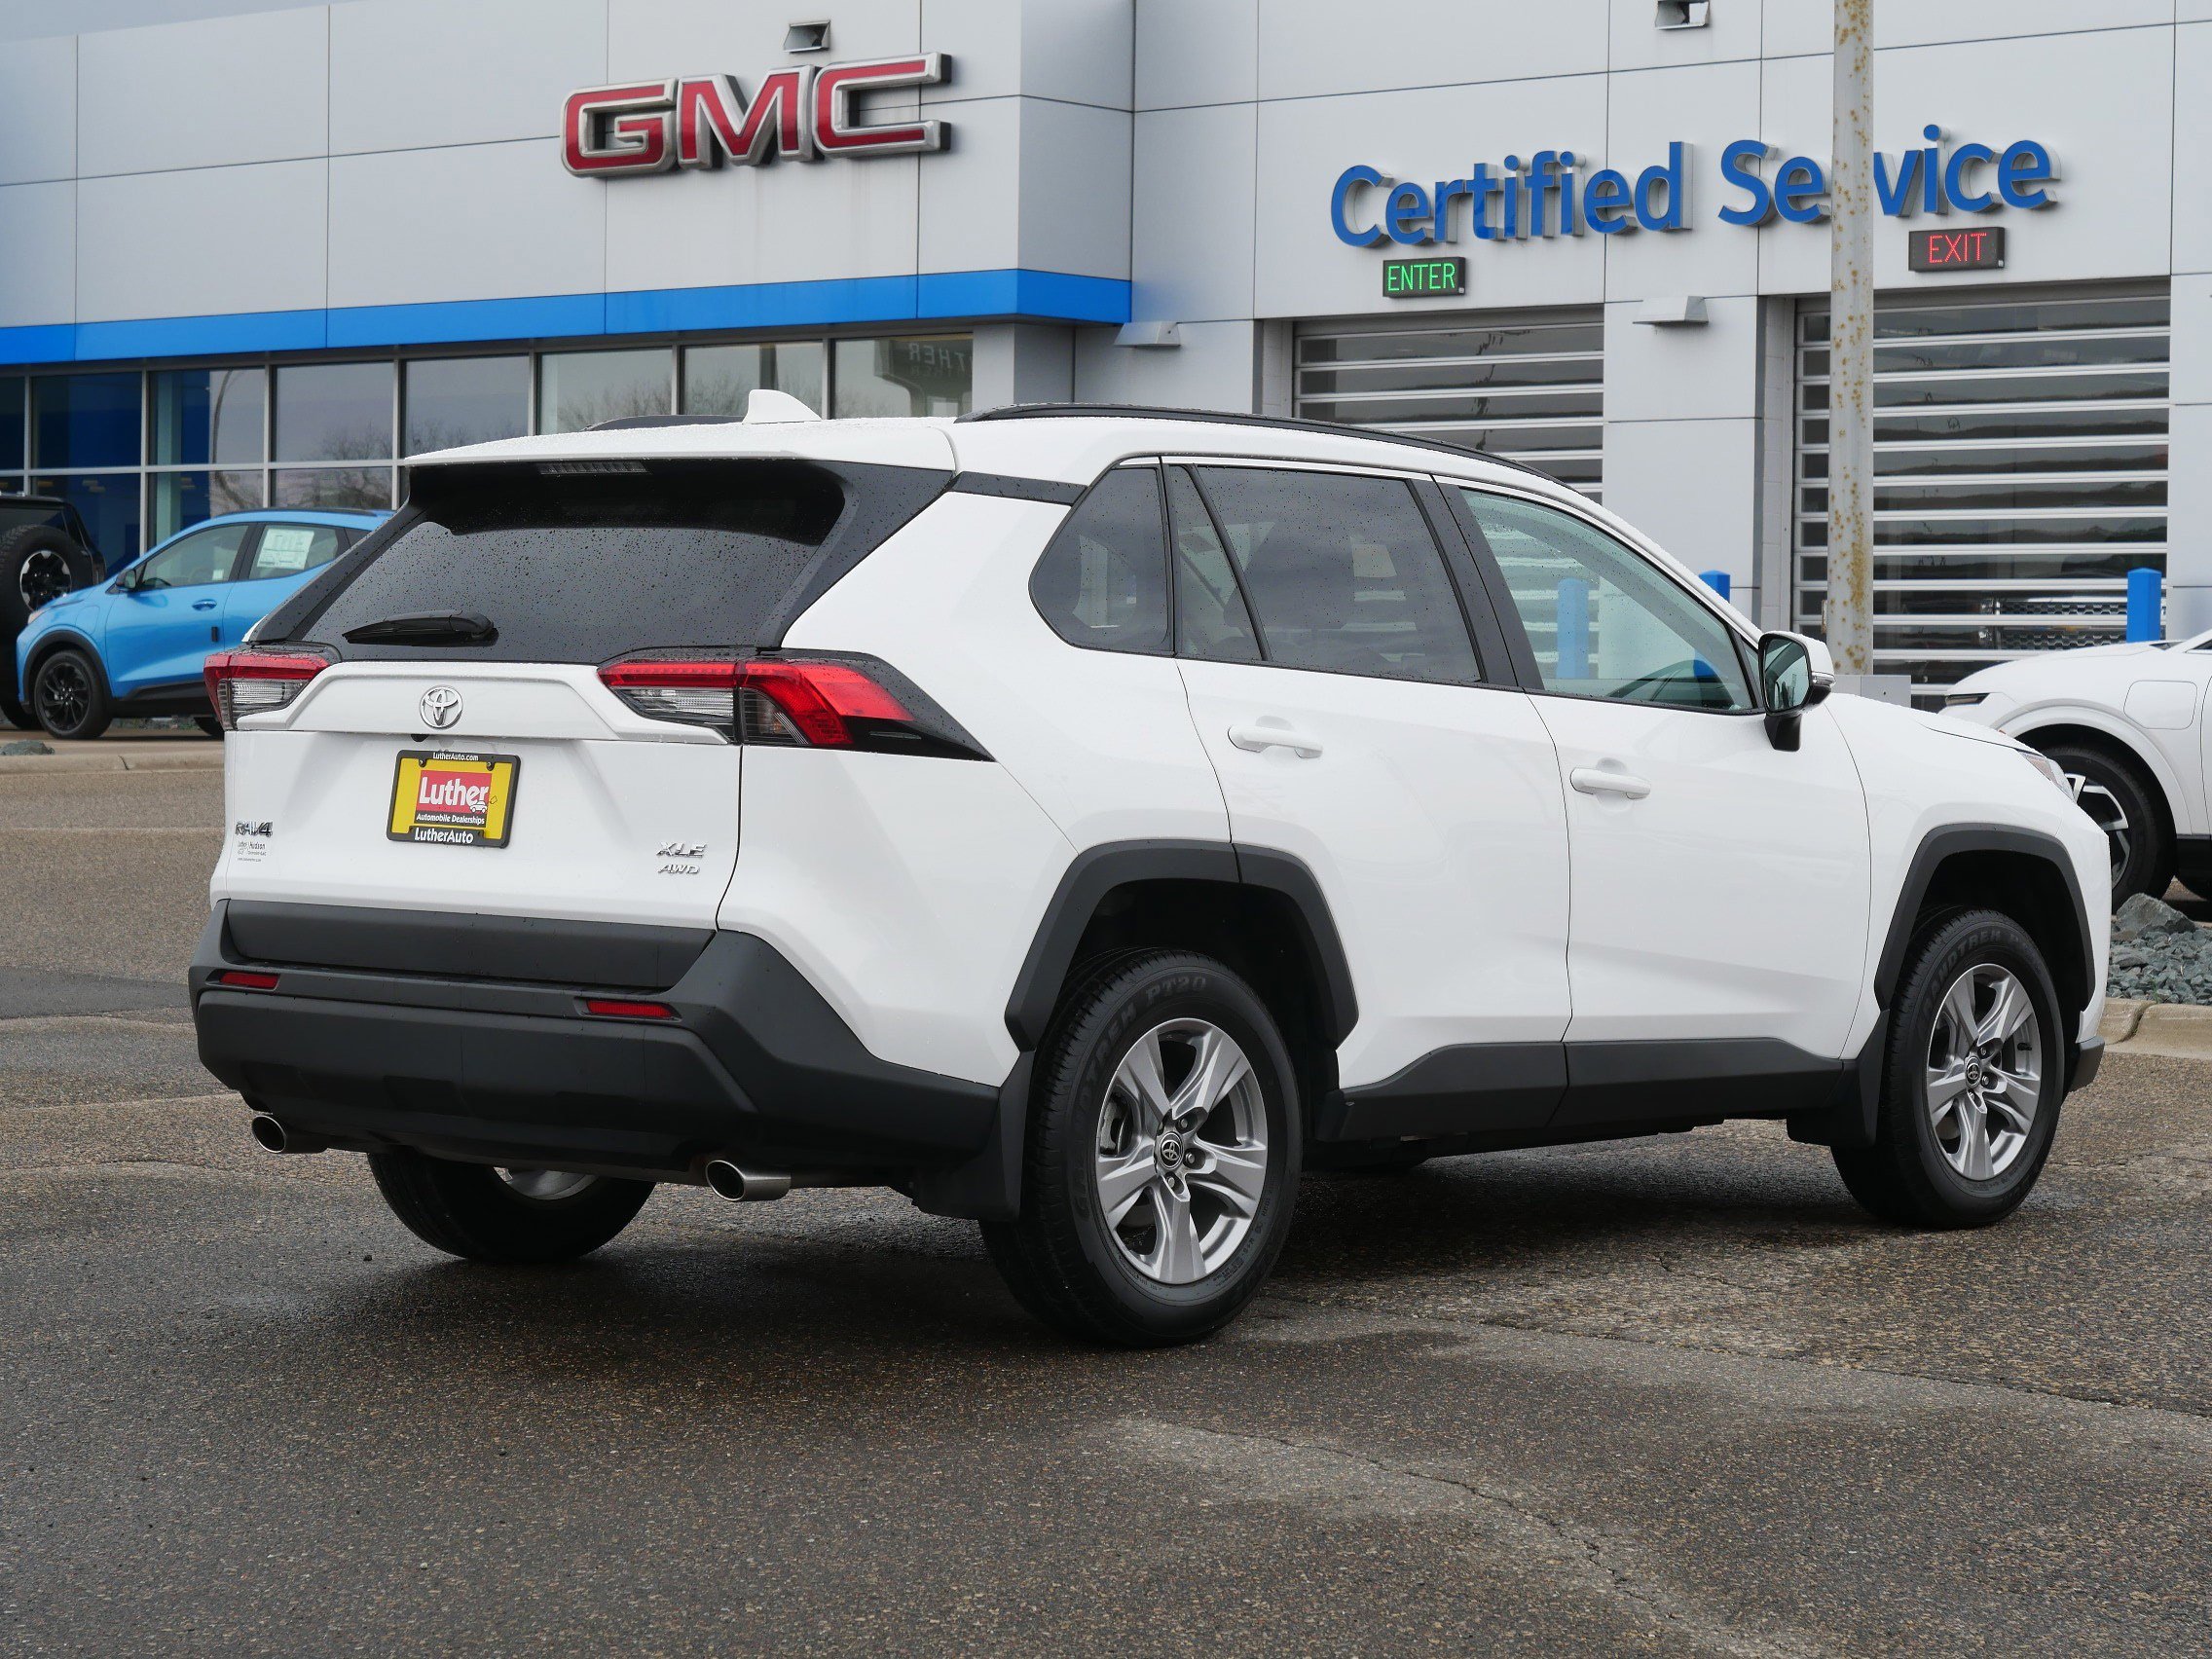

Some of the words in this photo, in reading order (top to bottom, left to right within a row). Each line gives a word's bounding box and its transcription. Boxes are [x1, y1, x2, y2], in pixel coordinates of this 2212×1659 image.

[560, 52, 951, 177] GMC
[1330, 141, 1693, 248] Certified
[1717, 124, 2061, 226] Sevice
[1929, 232, 1987, 264] EXIT
[1387, 262, 1456, 291] ENTER
[432, 752, 479, 761] LutherAuto.com
[419, 776, 489, 806] Luther
[416, 813, 451, 823] Automobile
[451, 814, 485, 826] Dealerships
[235, 821, 273, 837] RAV4
[415, 827, 474, 844] LutherAuto
[656, 842, 707, 858] XLE
[658, 864, 701, 874] AWD
